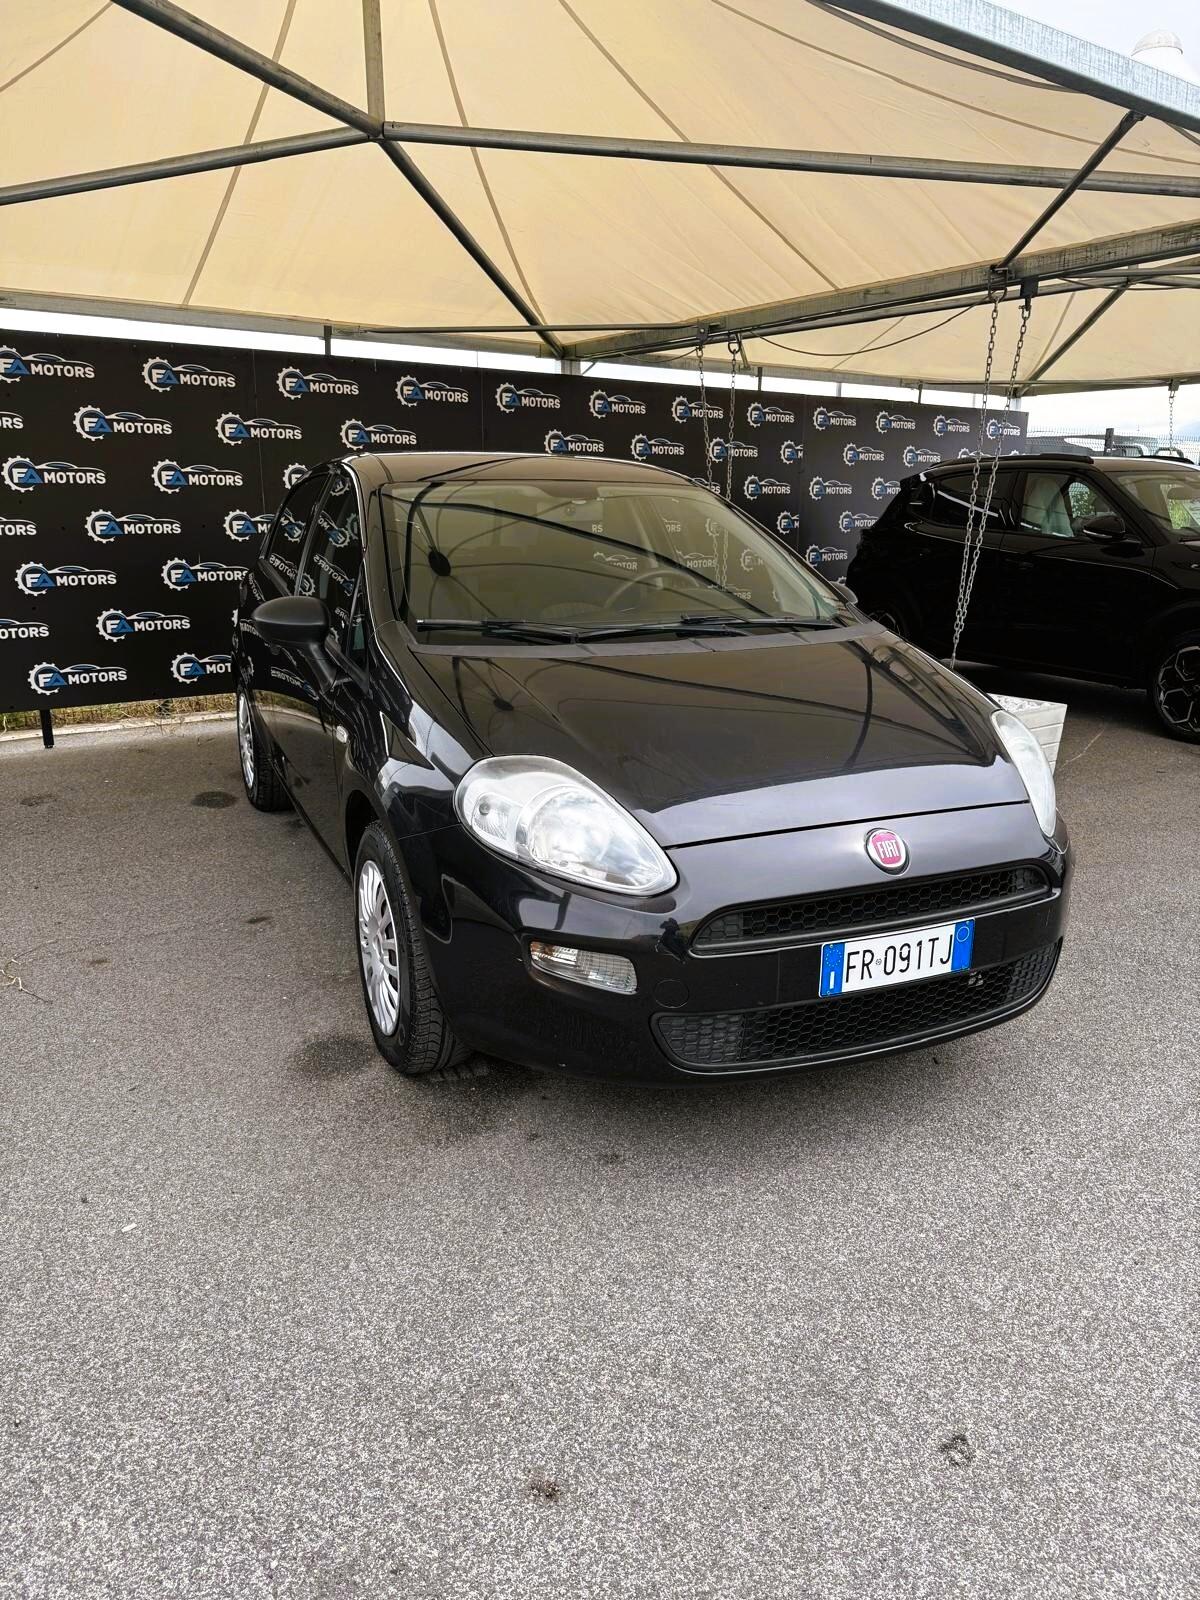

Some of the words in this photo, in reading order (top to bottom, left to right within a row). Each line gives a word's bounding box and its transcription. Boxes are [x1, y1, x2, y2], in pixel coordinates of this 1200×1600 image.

[31, 363, 95, 378] MOTORS
[180, 374, 236, 387] MOTORS
[310, 382, 359, 395] MOTORS
[425, 390, 469, 403] MOTORS
[521, 396, 561, 409] MOTORS
[612, 402, 646, 415] MOTORS
[692, 408, 723, 419] MOTORS
[766, 413, 794, 423] MOTORS
[830, 418, 856, 426] MOTORS
[113, 421, 172, 434] MOTORS
[891, 421, 915, 430] MOTORS
[948, 424, 970, 433] MOTORS
[251, 428, 302, 440] MOTORS
[371, 433, 417, 445] MOTORS
[568, 441, 604, 452] MOTORS
[652, 444, 684, 455] MOTORS
[859, 452, 884, 461] MOTORS
[918, 454, 941, 462] MOTORS
[44, 471, 106, 484] MOTORS
[189, 474, 243, 486] MOTORS
[762, 486, 790, 494] MOTORS
[826, 487, 852, 495] MOTORS
[124, 523, 181, 534] MOTORS
[855, 519, 877, 528] MOTOR
[0, 524, 37, 536] TORS
[821, 552, 848, 561] MOTORS
[57, 574, 117, 586] MOTORS
[134, 618, 190, 632] MOTORS
[0, 626, 49, 640] OTORS
[206, 662, 232, 674] MOT
[68, 670, 127, 685] MOTORS
[877, 840, 899, 859] FIAT
[845, 949, 875, 983] FR
[883, 934, 953, 976] 091TJ
